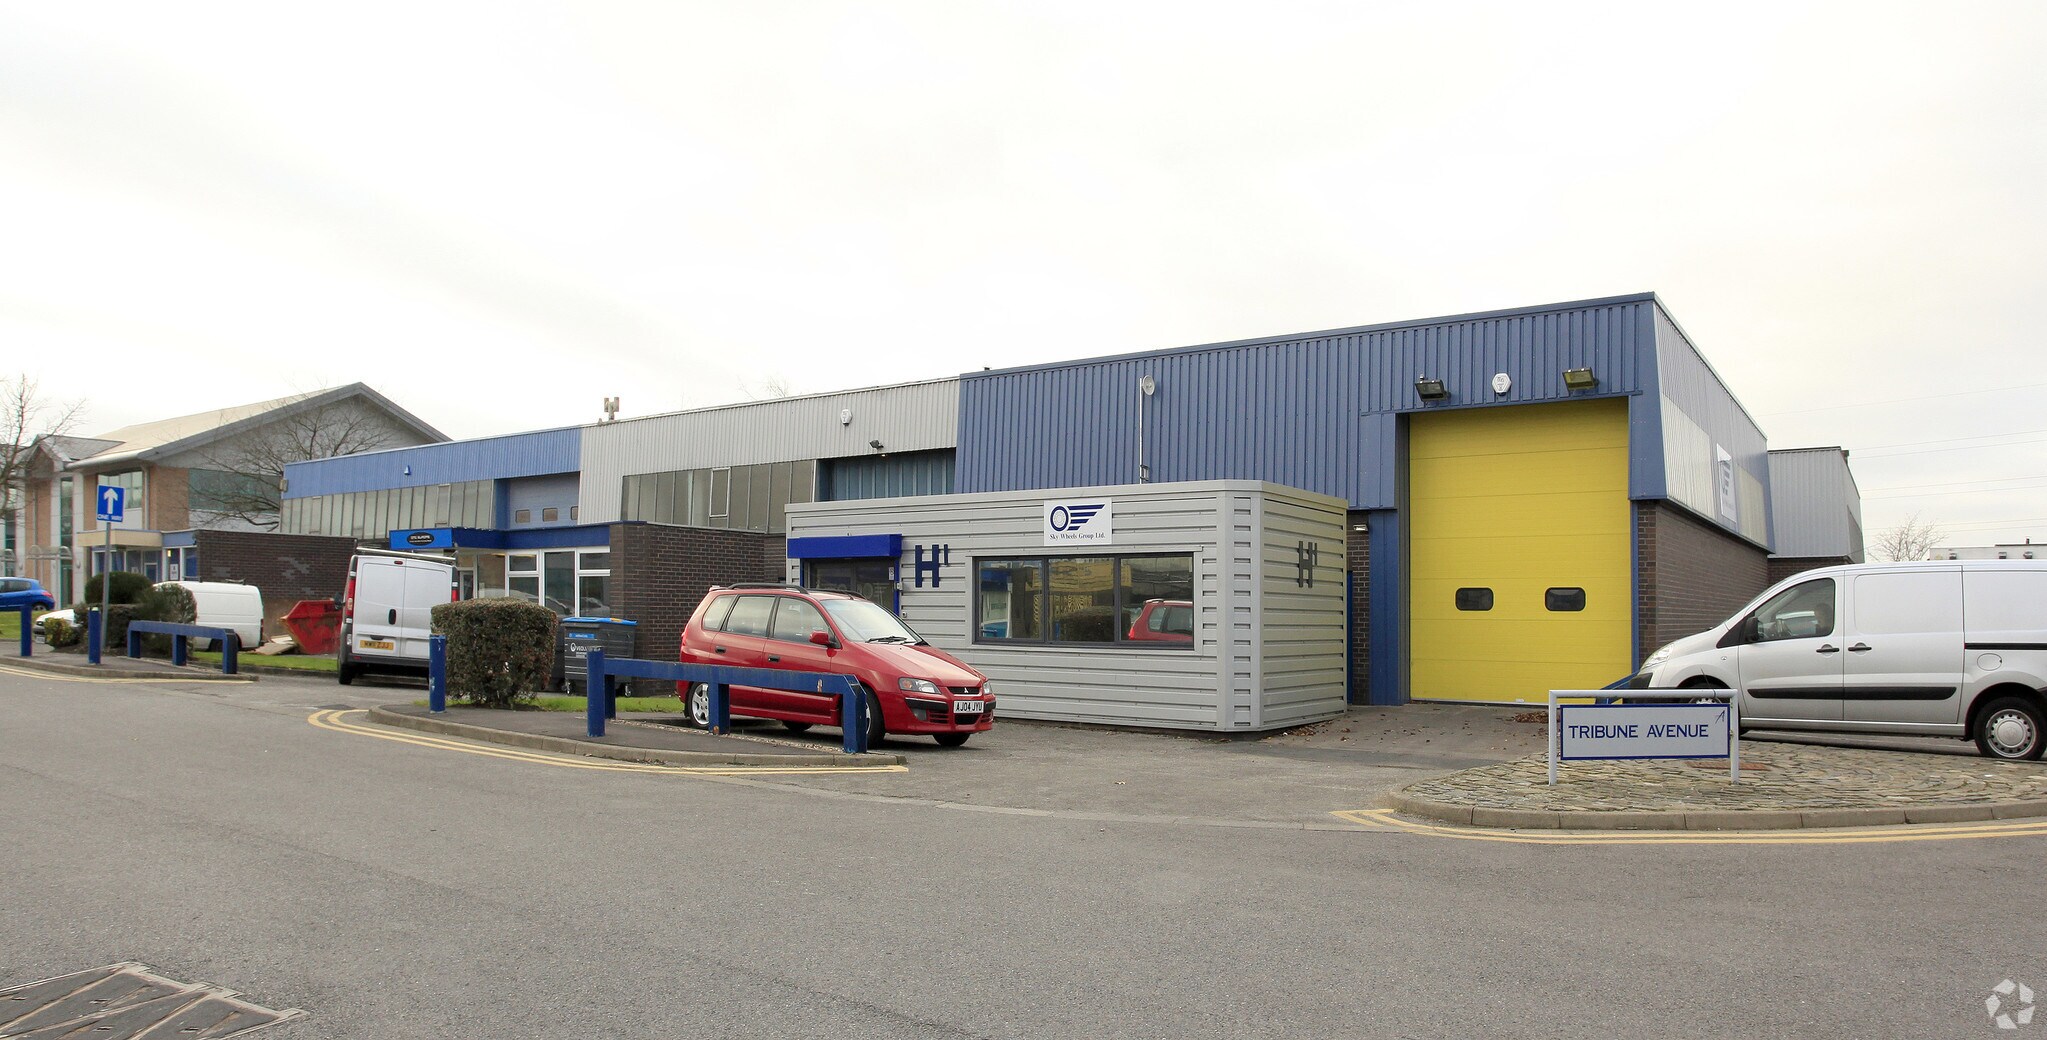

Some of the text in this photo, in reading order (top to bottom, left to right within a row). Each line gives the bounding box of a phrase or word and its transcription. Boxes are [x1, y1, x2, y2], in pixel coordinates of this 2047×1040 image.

[956, 702, 971, 711] AJ04
[1568, 724, 1709, 739] TRIBUNE AVENUE
